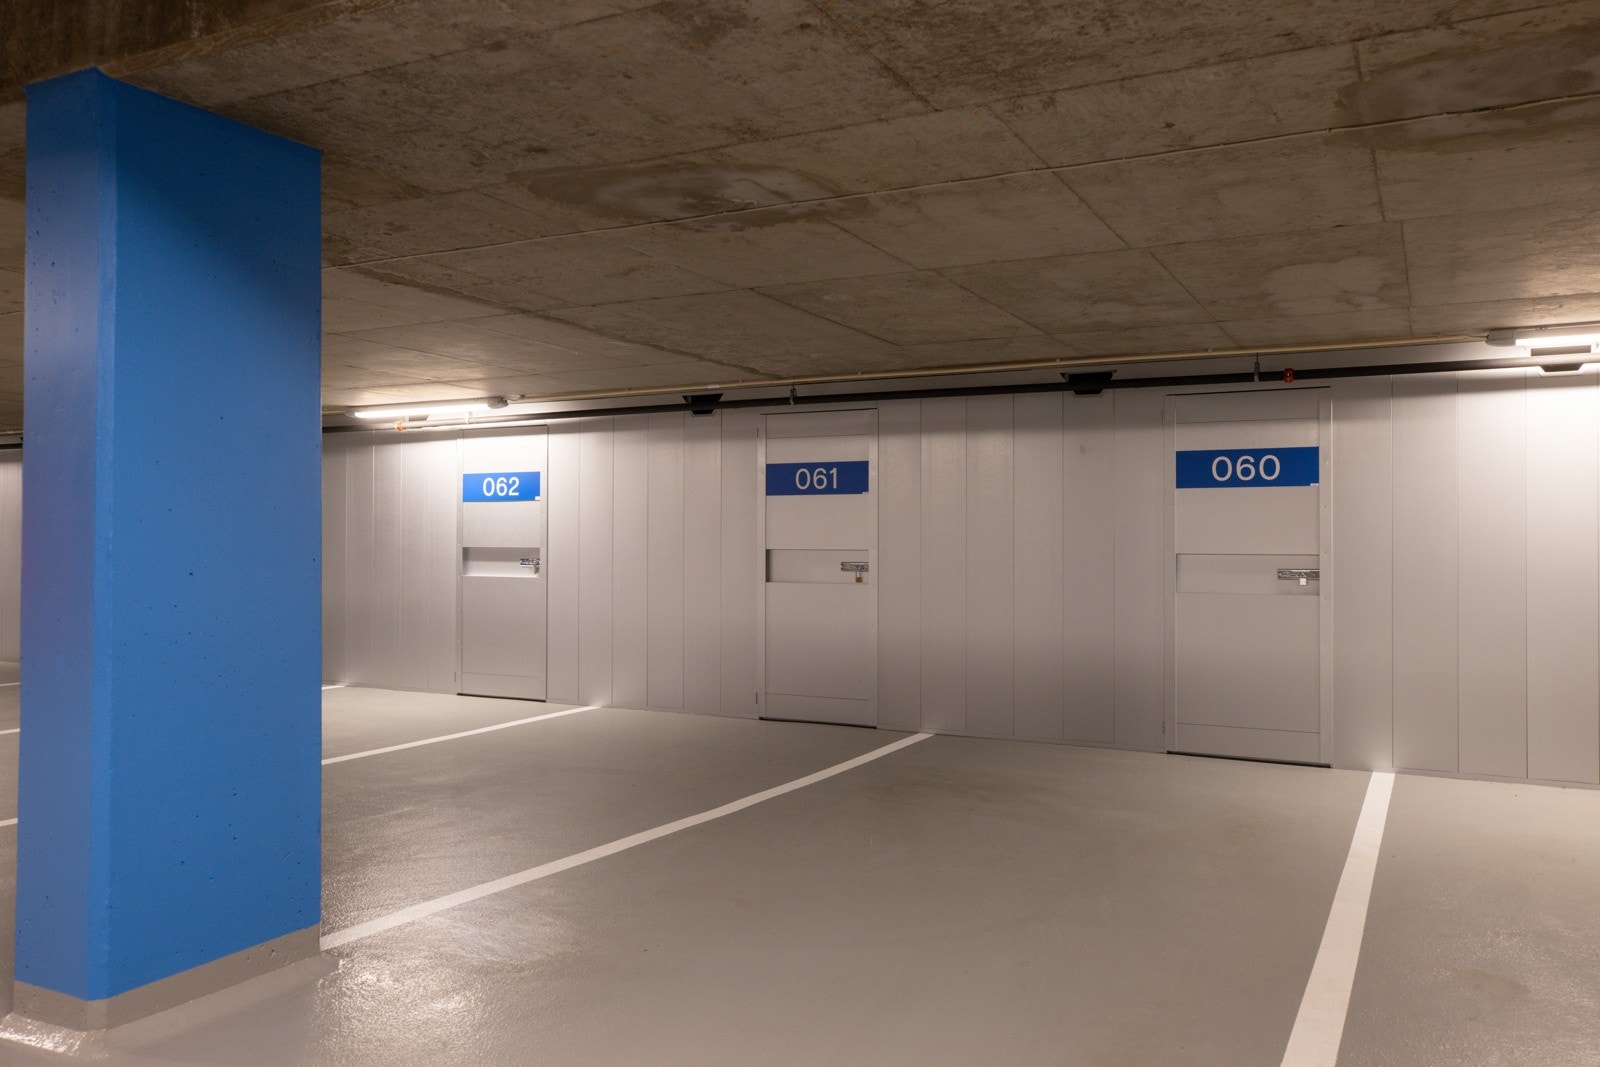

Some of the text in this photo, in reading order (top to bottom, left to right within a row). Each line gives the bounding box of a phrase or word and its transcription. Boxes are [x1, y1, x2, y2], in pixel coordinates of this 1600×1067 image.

[795, 467, 838, 490] 061
[1211, 454, 1281, 482] 060
[483, 476, 520, 496] 062
